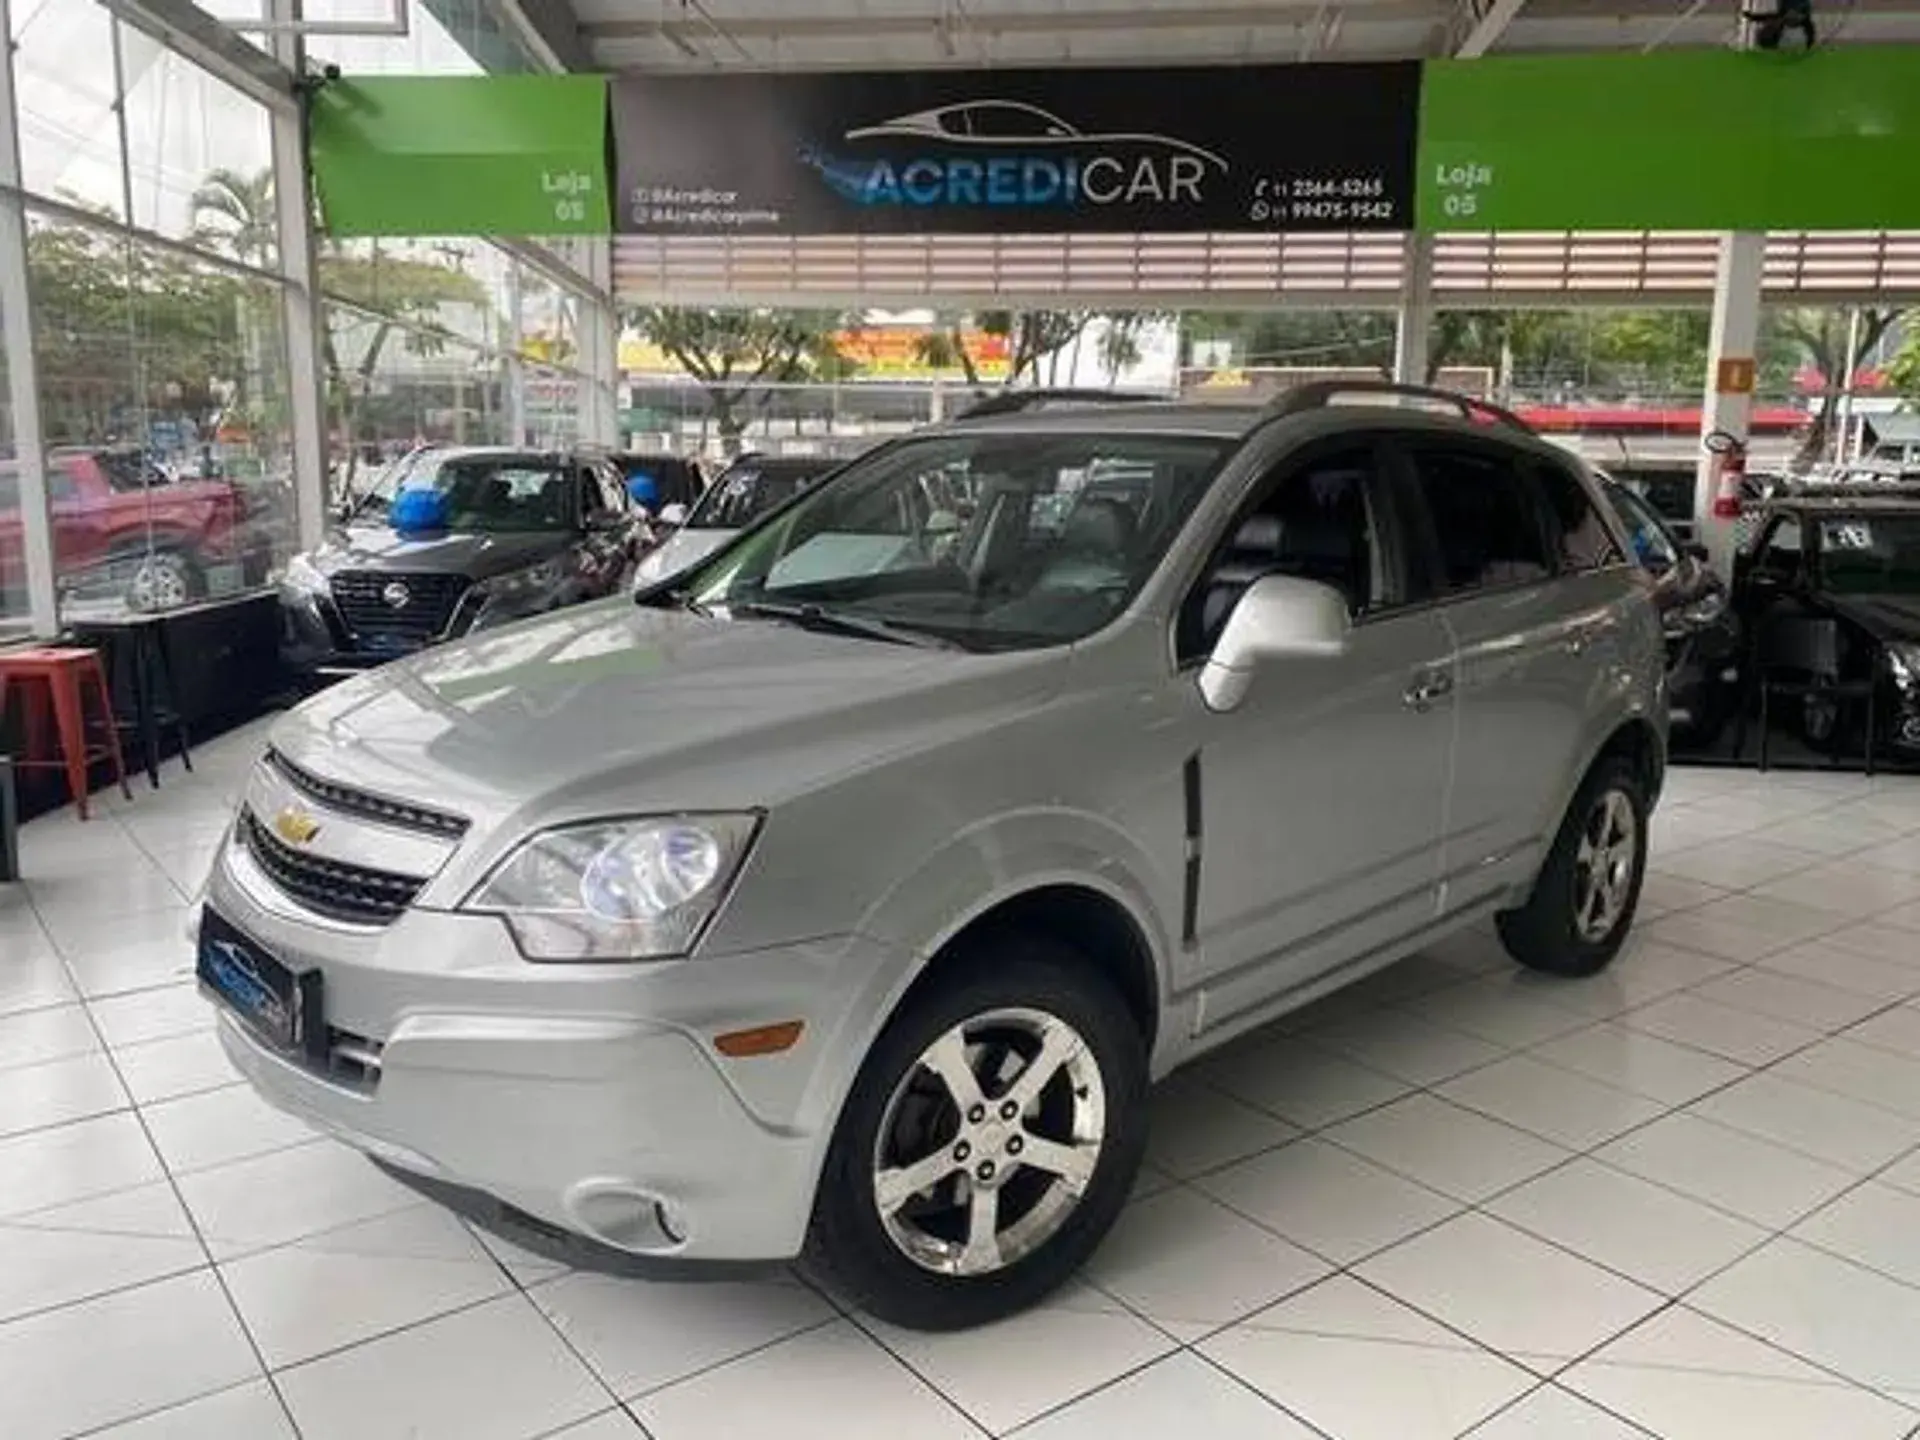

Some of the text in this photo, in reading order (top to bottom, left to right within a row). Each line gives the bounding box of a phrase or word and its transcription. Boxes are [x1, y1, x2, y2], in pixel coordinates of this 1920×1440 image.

[864, 157, 1205, 204] ACREDICAR
[1436, 164, 1492, 189] Loja
[1444, 195, 1477, 216] 05
